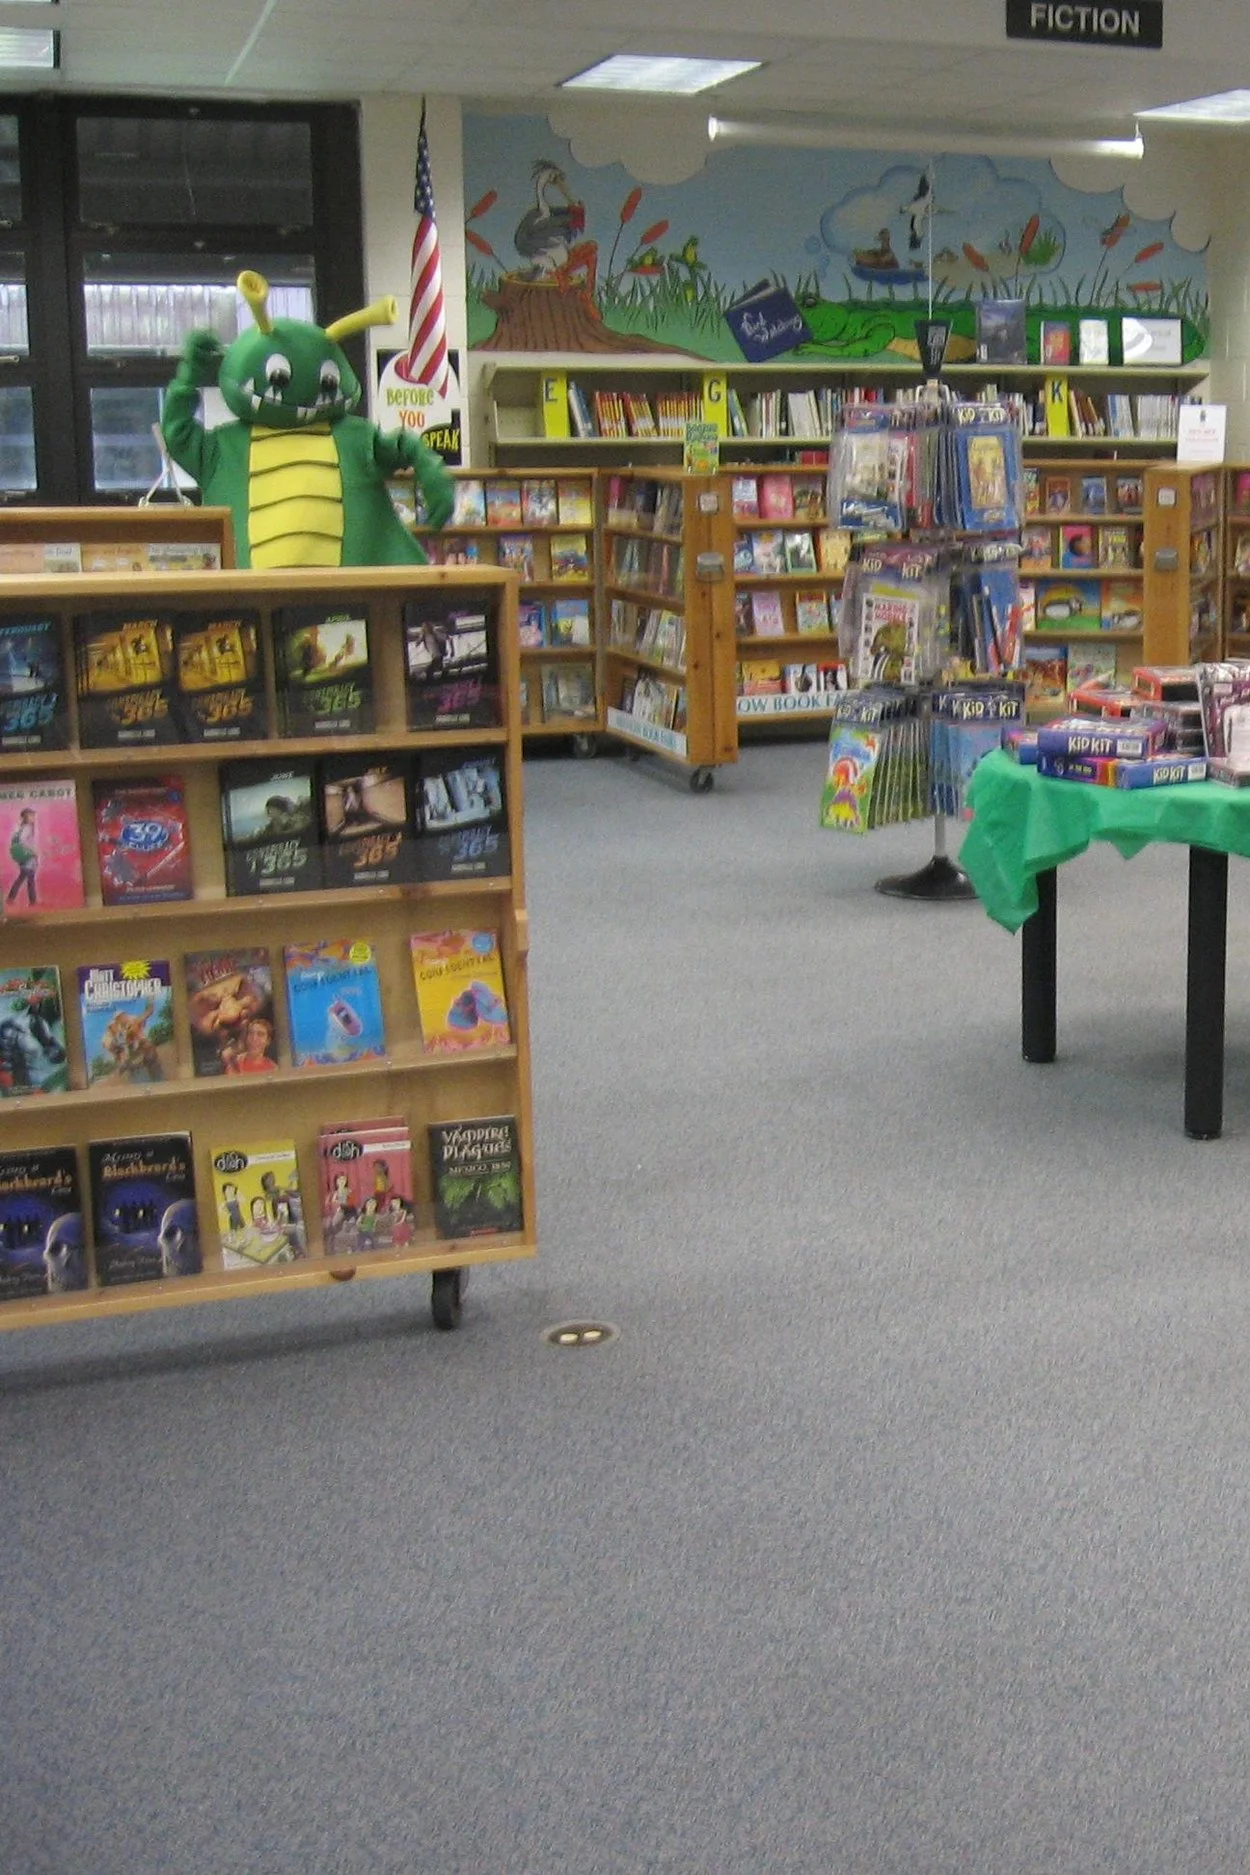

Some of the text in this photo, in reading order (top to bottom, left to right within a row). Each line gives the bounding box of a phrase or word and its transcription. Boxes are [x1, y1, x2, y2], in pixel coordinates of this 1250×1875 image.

[1031, 3, 1140, 35] FICTION
[708, 378, 722, 403] G
[1051, 380, 1064, 404] K
[399, 410, 425, 428] YOU
[423, 429, 460, 452] SPEAK
[738, 698, 768, 712] OW
[773, 695, 821, 711] BOOK
[131, 822, 162, 843] 39
